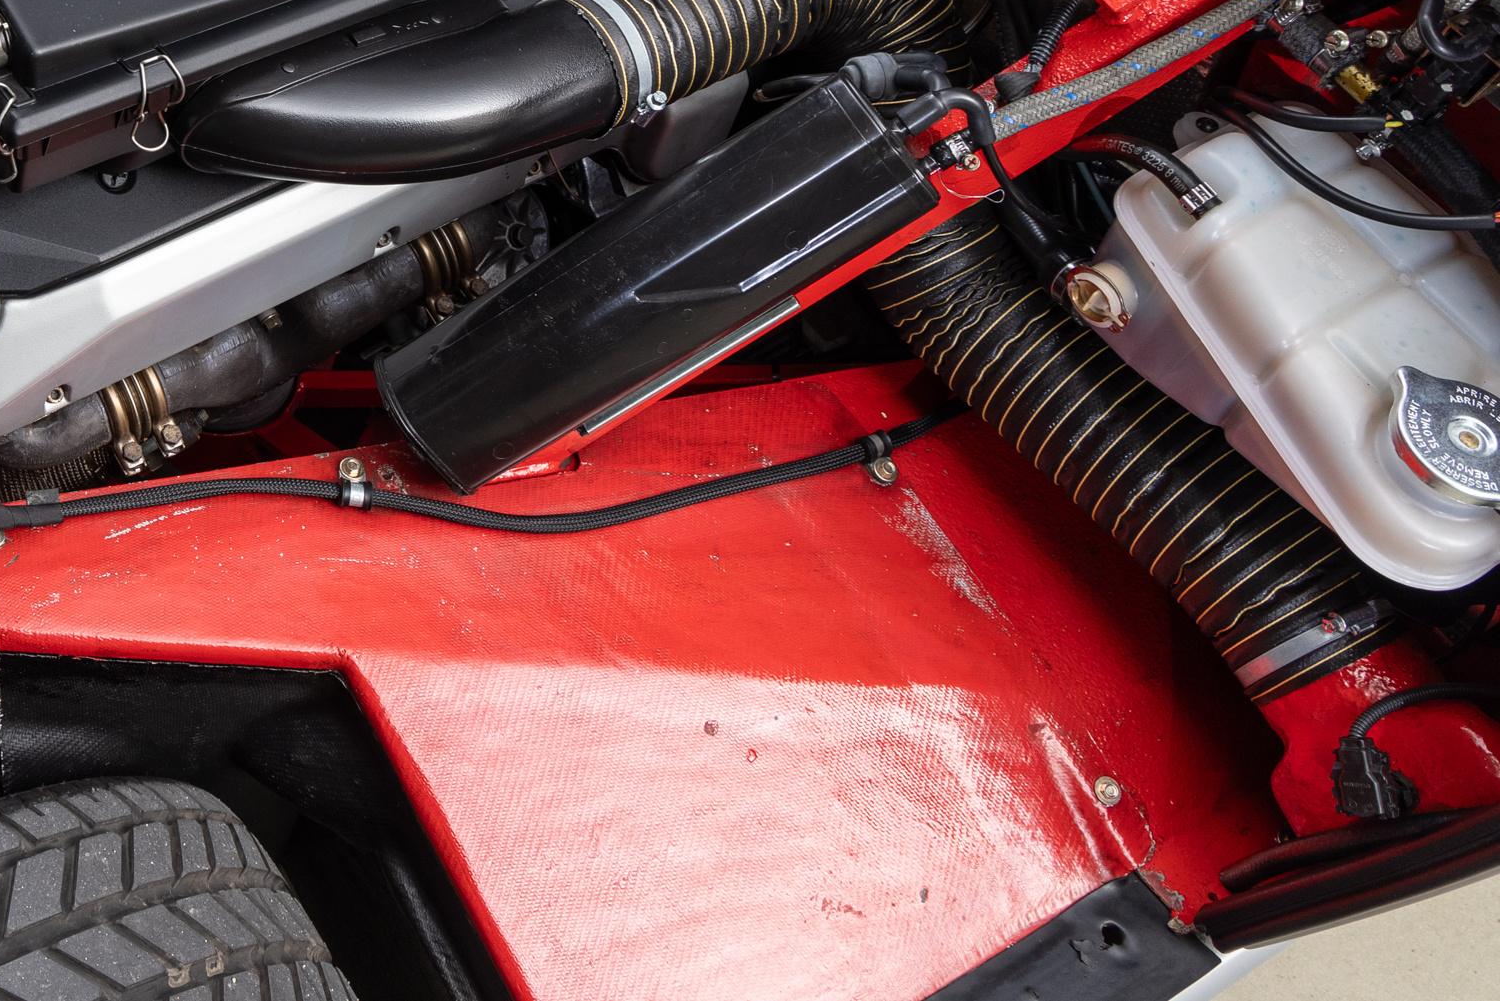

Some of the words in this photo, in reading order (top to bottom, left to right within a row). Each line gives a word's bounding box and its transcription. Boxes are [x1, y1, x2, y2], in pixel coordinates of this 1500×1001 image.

[1141, 151, 1168, 172] 3225
[1164, 168, 1175, 178] 8
[1171, 175, 1188, 193] mm
[1449, 395, 1485, 410] ABRIR
[1456, 386, 1498, 408] APRIRE
[1420, 408, 1440, 449] SLOWLY
[1431, 457, 1499, 492] DESSERRER
[1441, 452, 1490, 480] REMOVE
